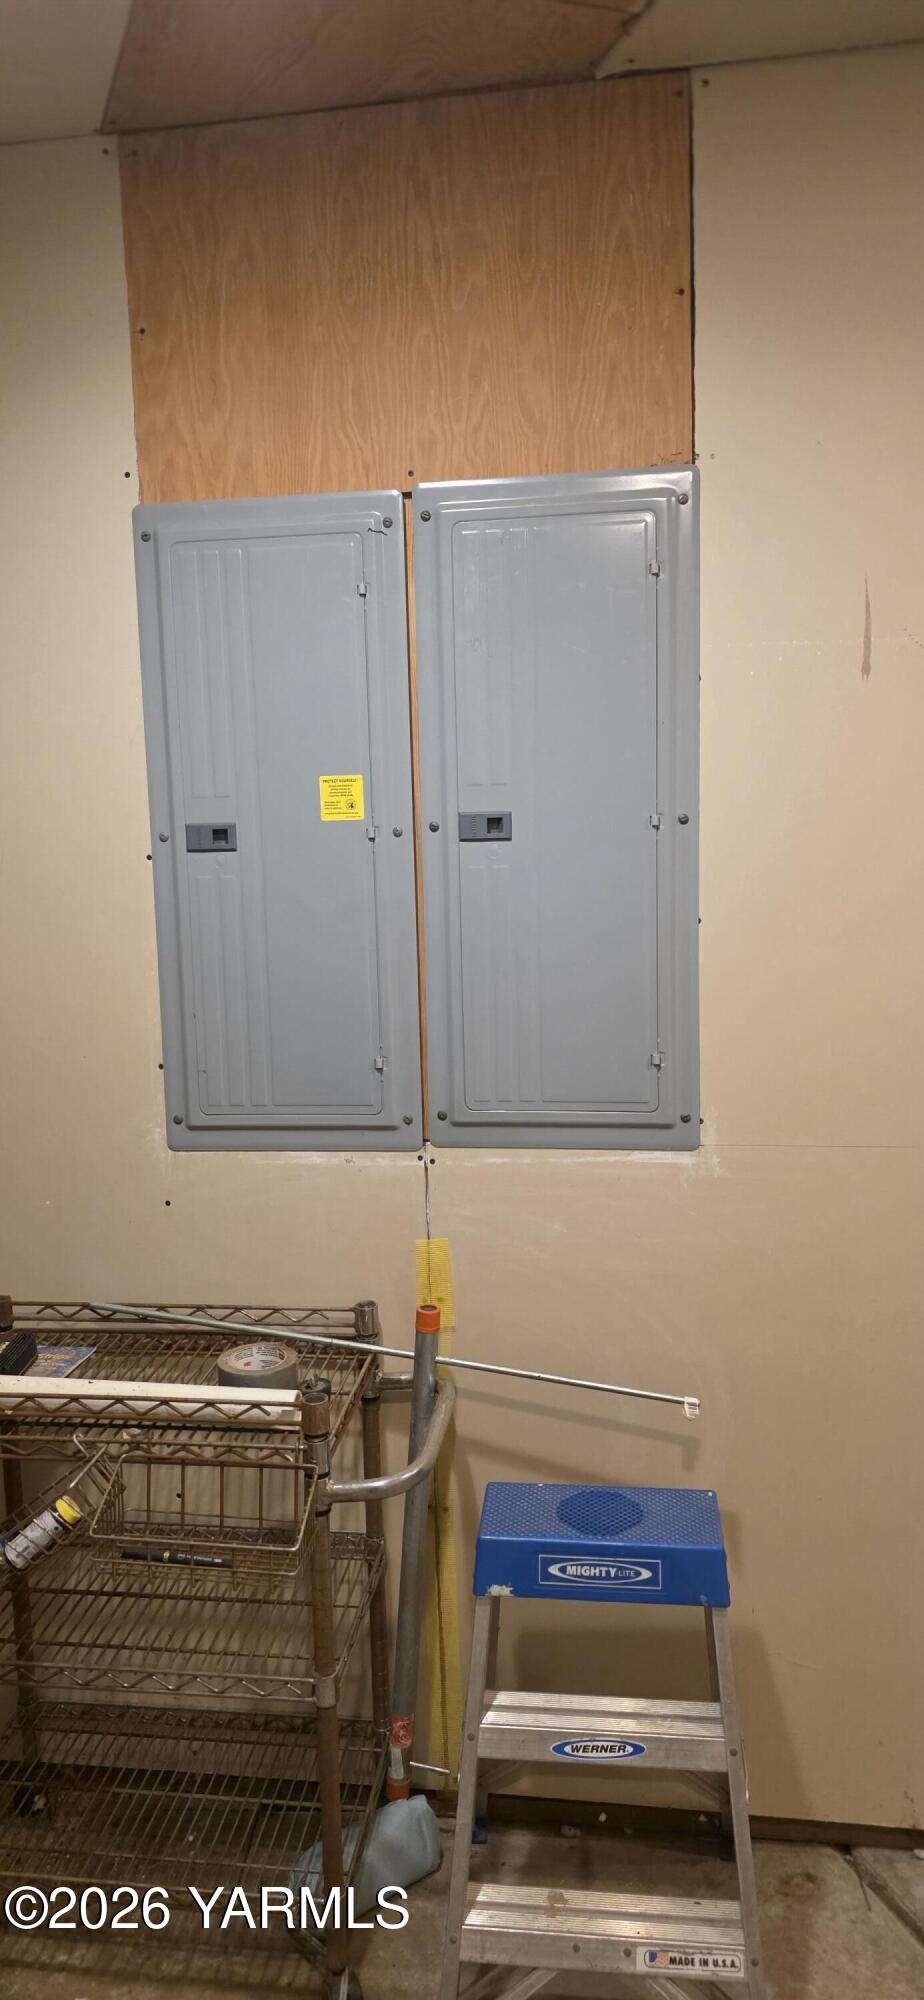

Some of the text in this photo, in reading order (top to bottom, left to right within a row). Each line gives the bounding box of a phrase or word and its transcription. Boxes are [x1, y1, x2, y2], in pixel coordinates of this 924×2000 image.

[570, 1744, 627, 1754] WERNER
[669, 1956, 739, 1969] MADE IN U.S.A.
